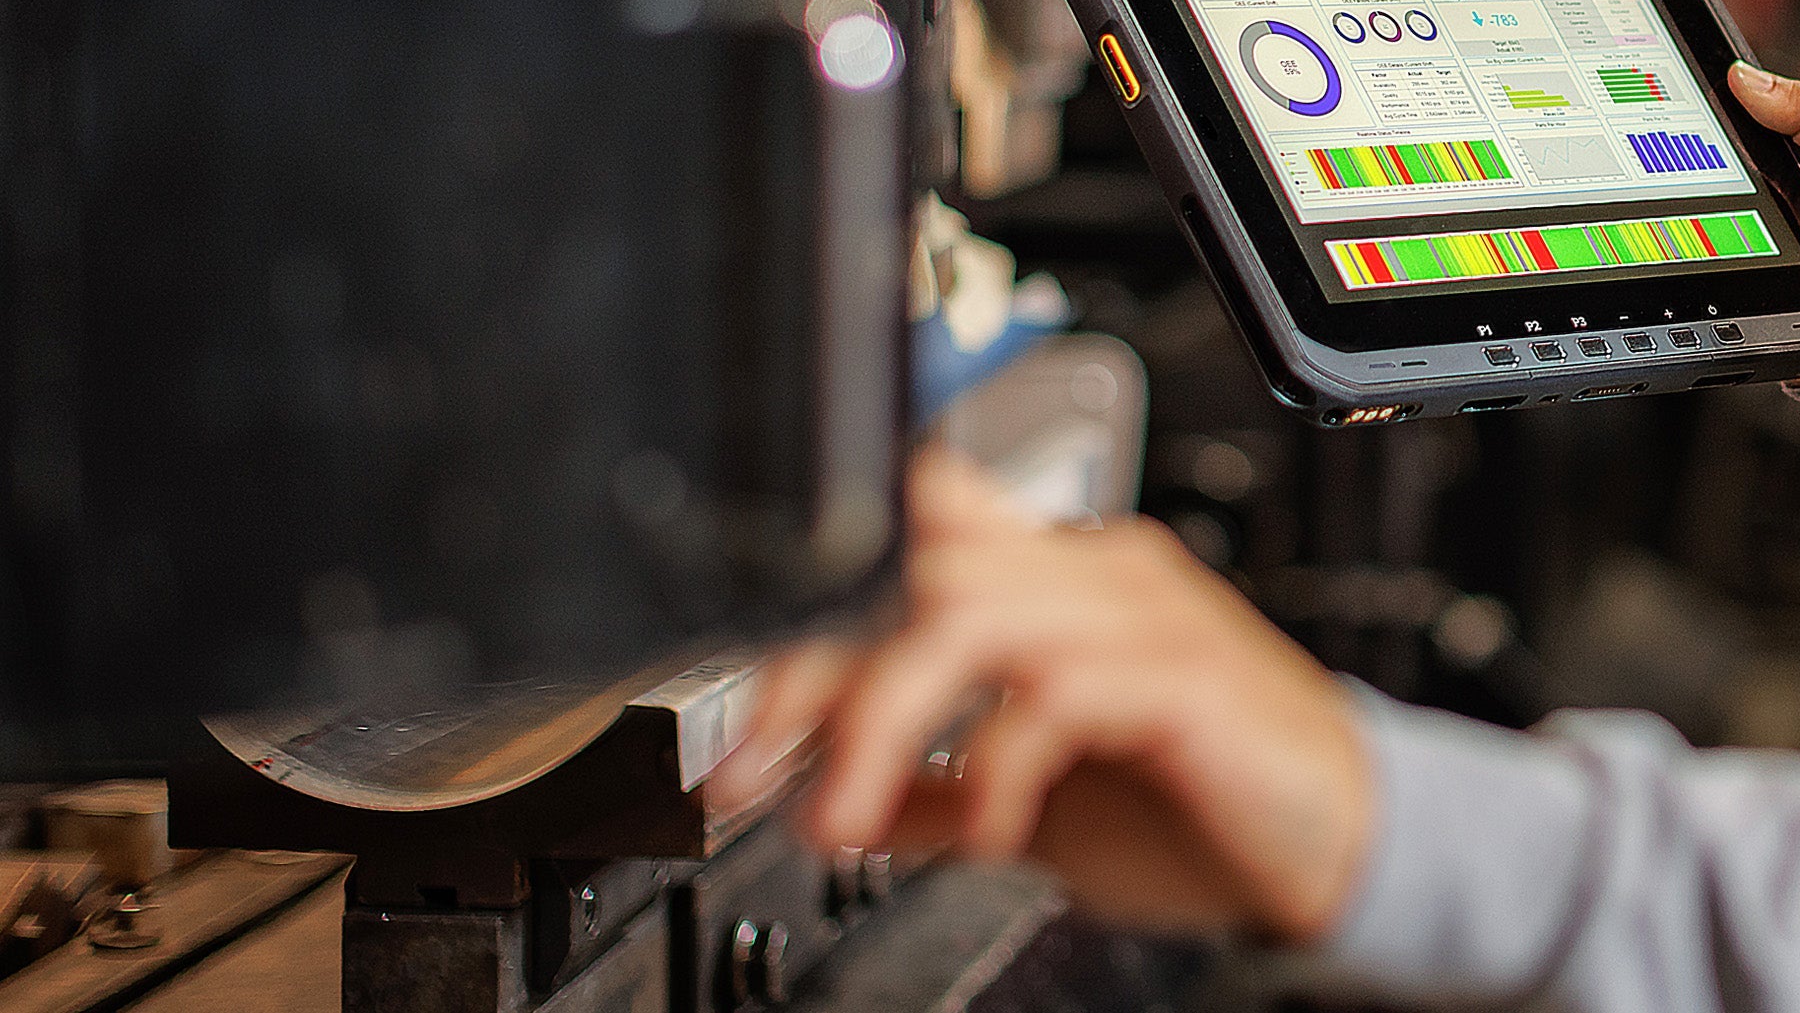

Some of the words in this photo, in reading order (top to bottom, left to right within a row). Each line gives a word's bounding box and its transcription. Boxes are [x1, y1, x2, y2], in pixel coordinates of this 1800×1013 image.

[1490, 14, 1518, 26] -783
[1280, 60, 1298, 68] OEE
[1525, 320, 1542, 332] P2
[1571, 316, 1588, 328] P3
[1477, 324, 1493, 336] P1
